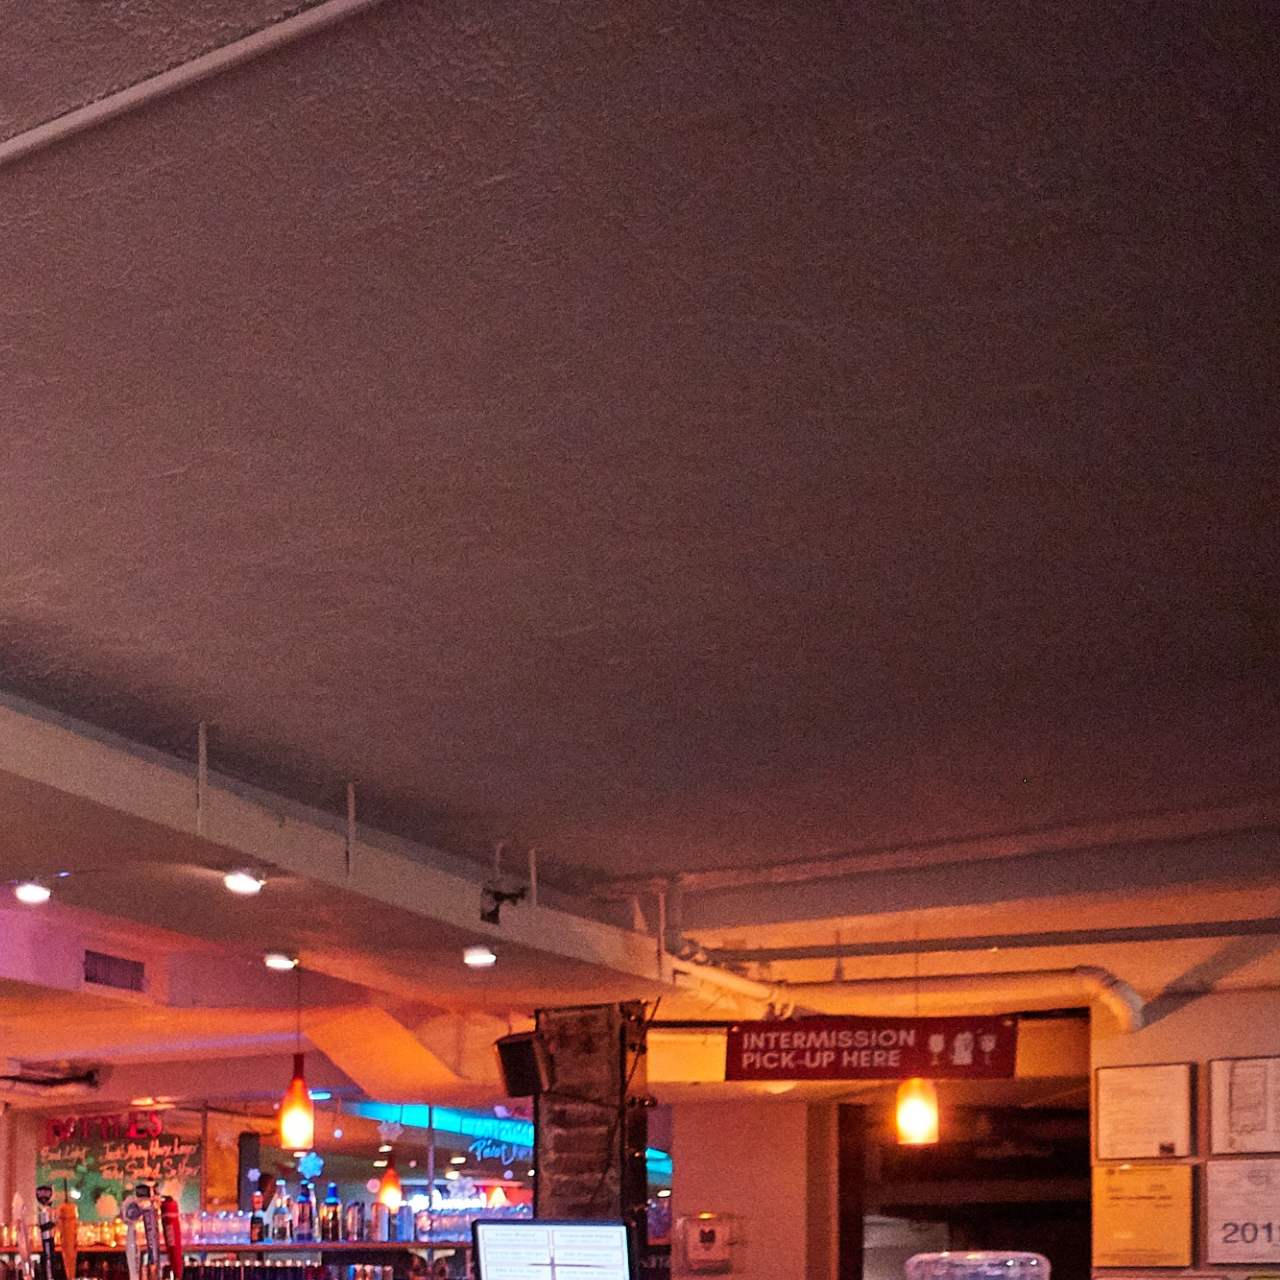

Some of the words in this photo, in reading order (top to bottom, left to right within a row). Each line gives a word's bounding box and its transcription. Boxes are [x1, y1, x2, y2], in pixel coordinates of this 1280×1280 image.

[743, 1030, 916, 1050] INTERMISSION
[741, 1050, 835, 1069] PICK-UP
[842, 1050, 901, 1067] HERE
[1221, 1222, 1280, 1244] 201
